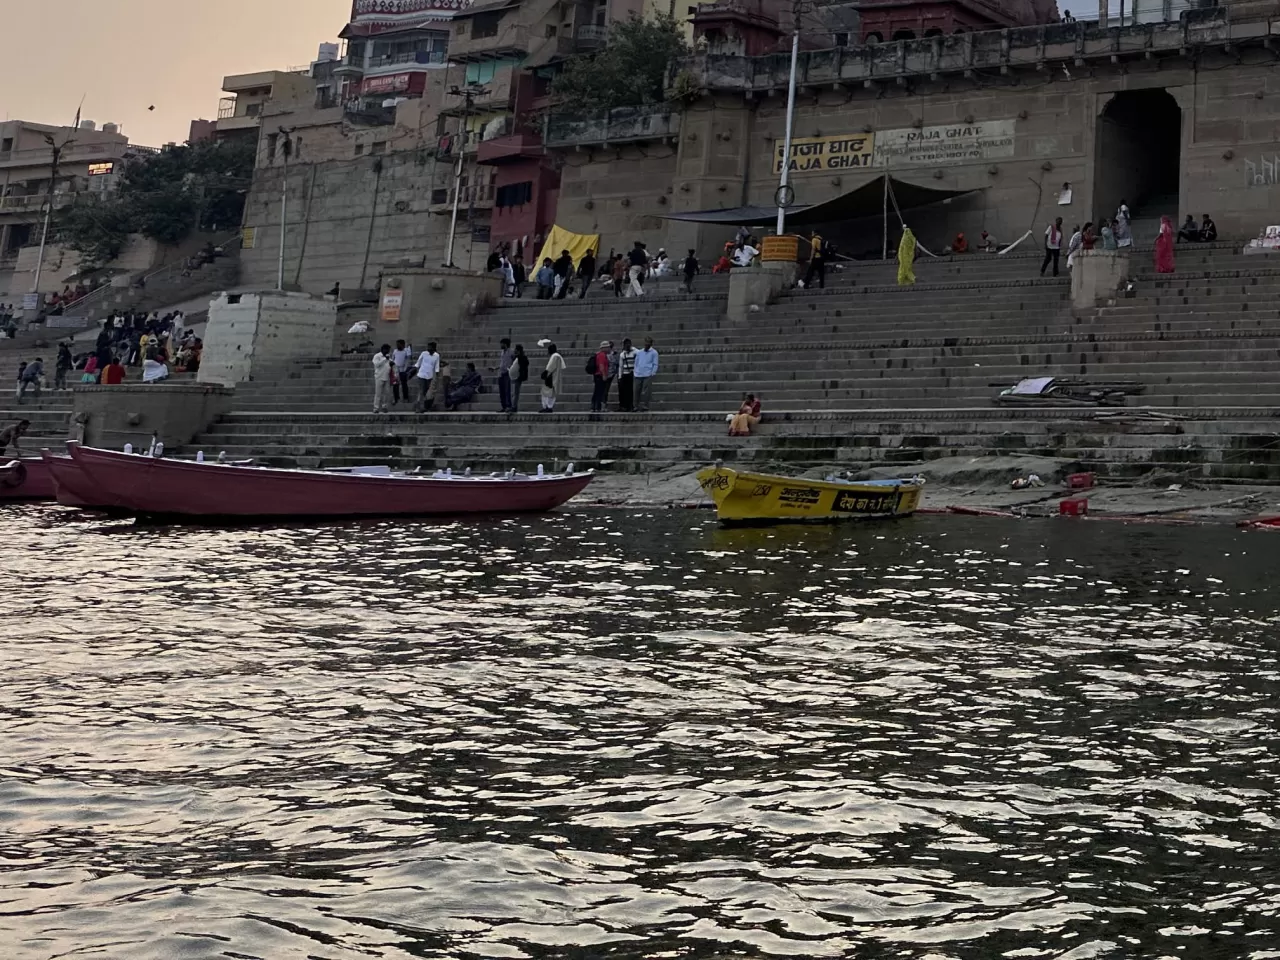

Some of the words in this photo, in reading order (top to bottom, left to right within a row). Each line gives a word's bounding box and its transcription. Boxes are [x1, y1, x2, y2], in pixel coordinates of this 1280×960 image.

[907, 130, 941, 141] RAJA
[945, 126, 982, 138] GHAT
[829, 138, 867, 154] घाट
[827, 153, 871, 168] GHAT
